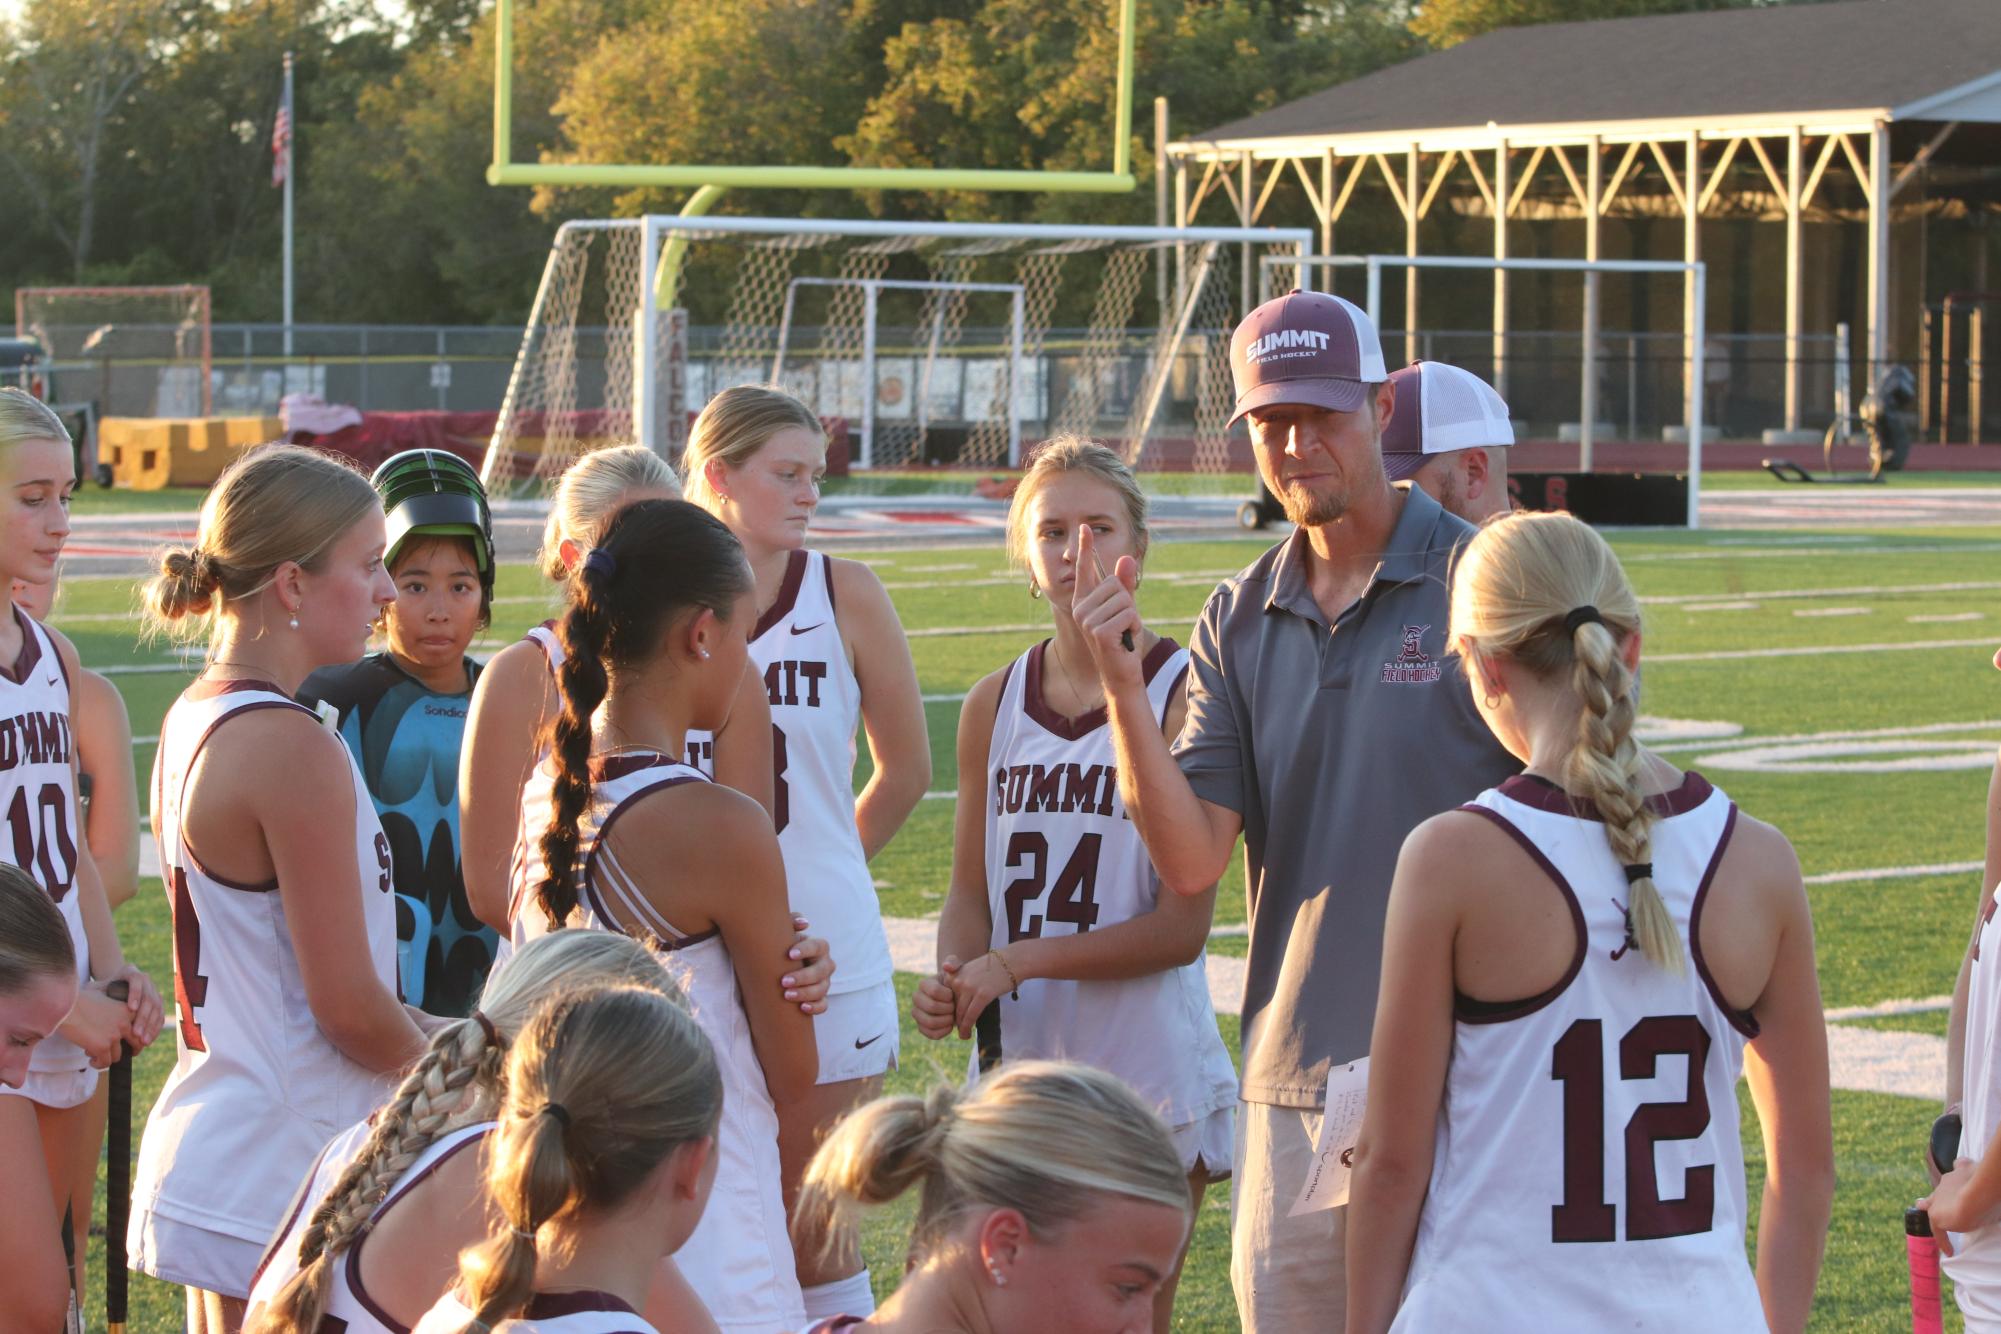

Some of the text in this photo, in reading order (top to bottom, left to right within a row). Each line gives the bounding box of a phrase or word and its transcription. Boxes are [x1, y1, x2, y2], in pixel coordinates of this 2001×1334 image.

[1246, 329, 1330, 365] SUMMIT
[1256, 350, 1318, 364] FIELD HOCKEY
[1380, 666, 1442, 683] FIELD HOCKEY
[1384, 661, 1440, 669] SUMMIT
[997, 763, 1133, 820] SUMMI
[6, 783, 78, 904] 10
[1004, 831, 1103, 945] 24
[1551, 1014, 1716, 1243] 12
